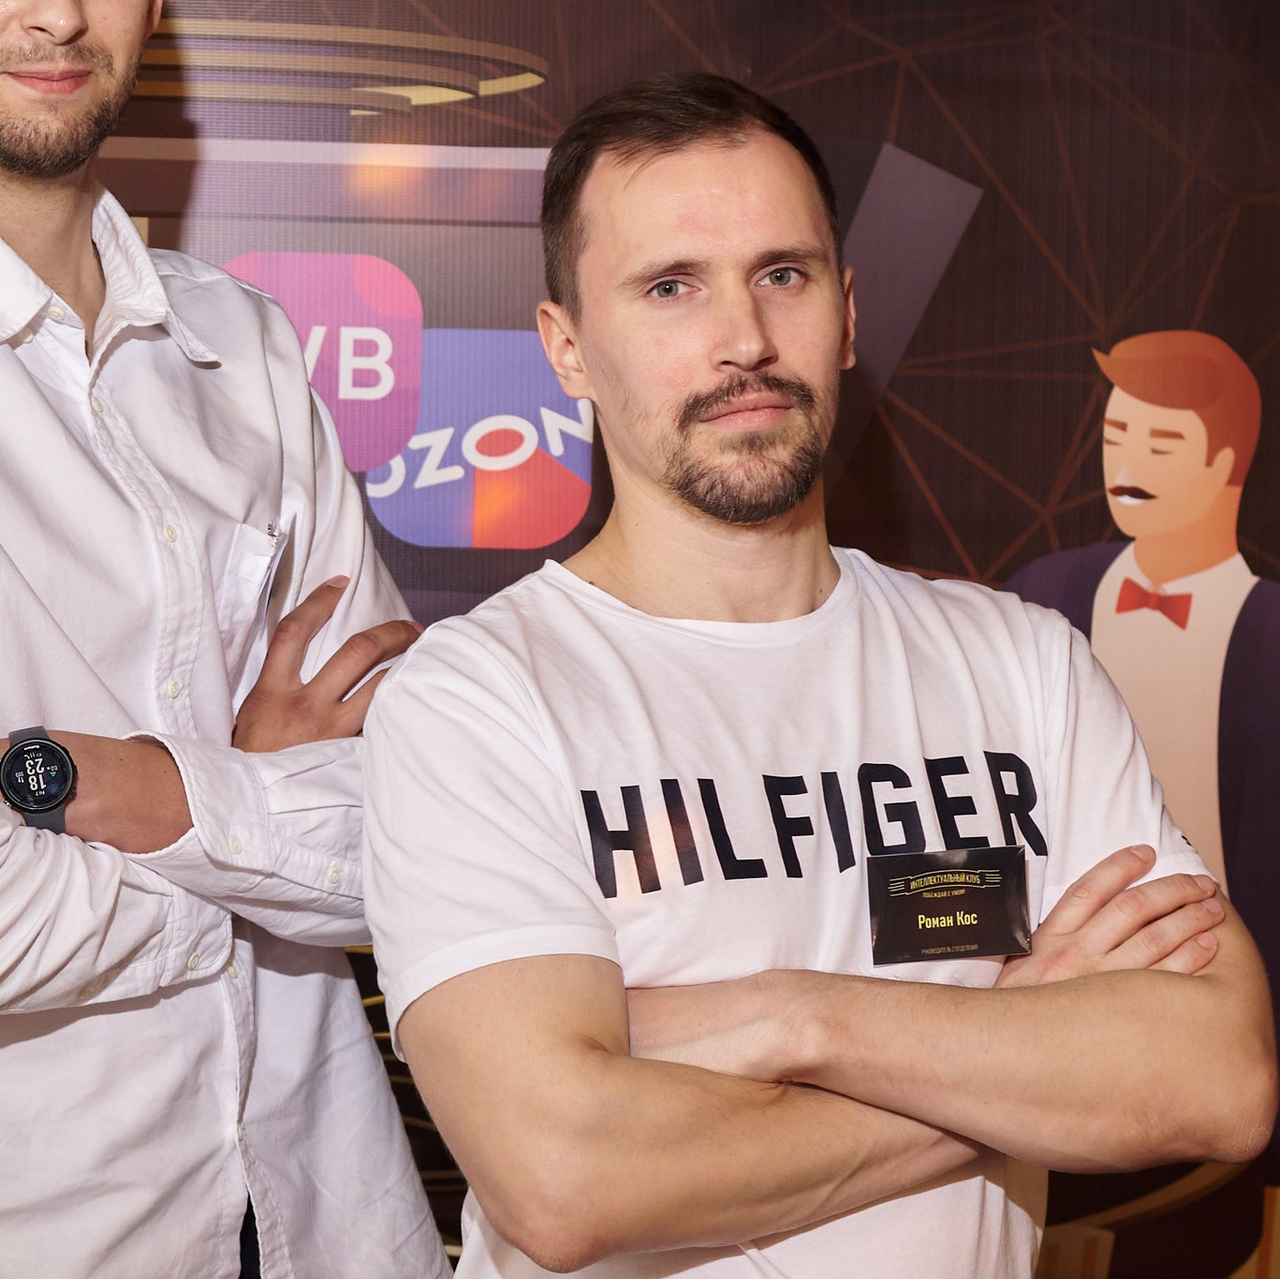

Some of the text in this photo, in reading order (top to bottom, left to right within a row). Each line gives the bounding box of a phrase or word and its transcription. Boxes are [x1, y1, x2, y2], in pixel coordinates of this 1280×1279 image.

[25, 758, 45, 775] 23
[28, 774, 47, 791] 18
[580, 750, 1048, 899] HILFIGER
[918, 911, 978, 929] Роман Кос
